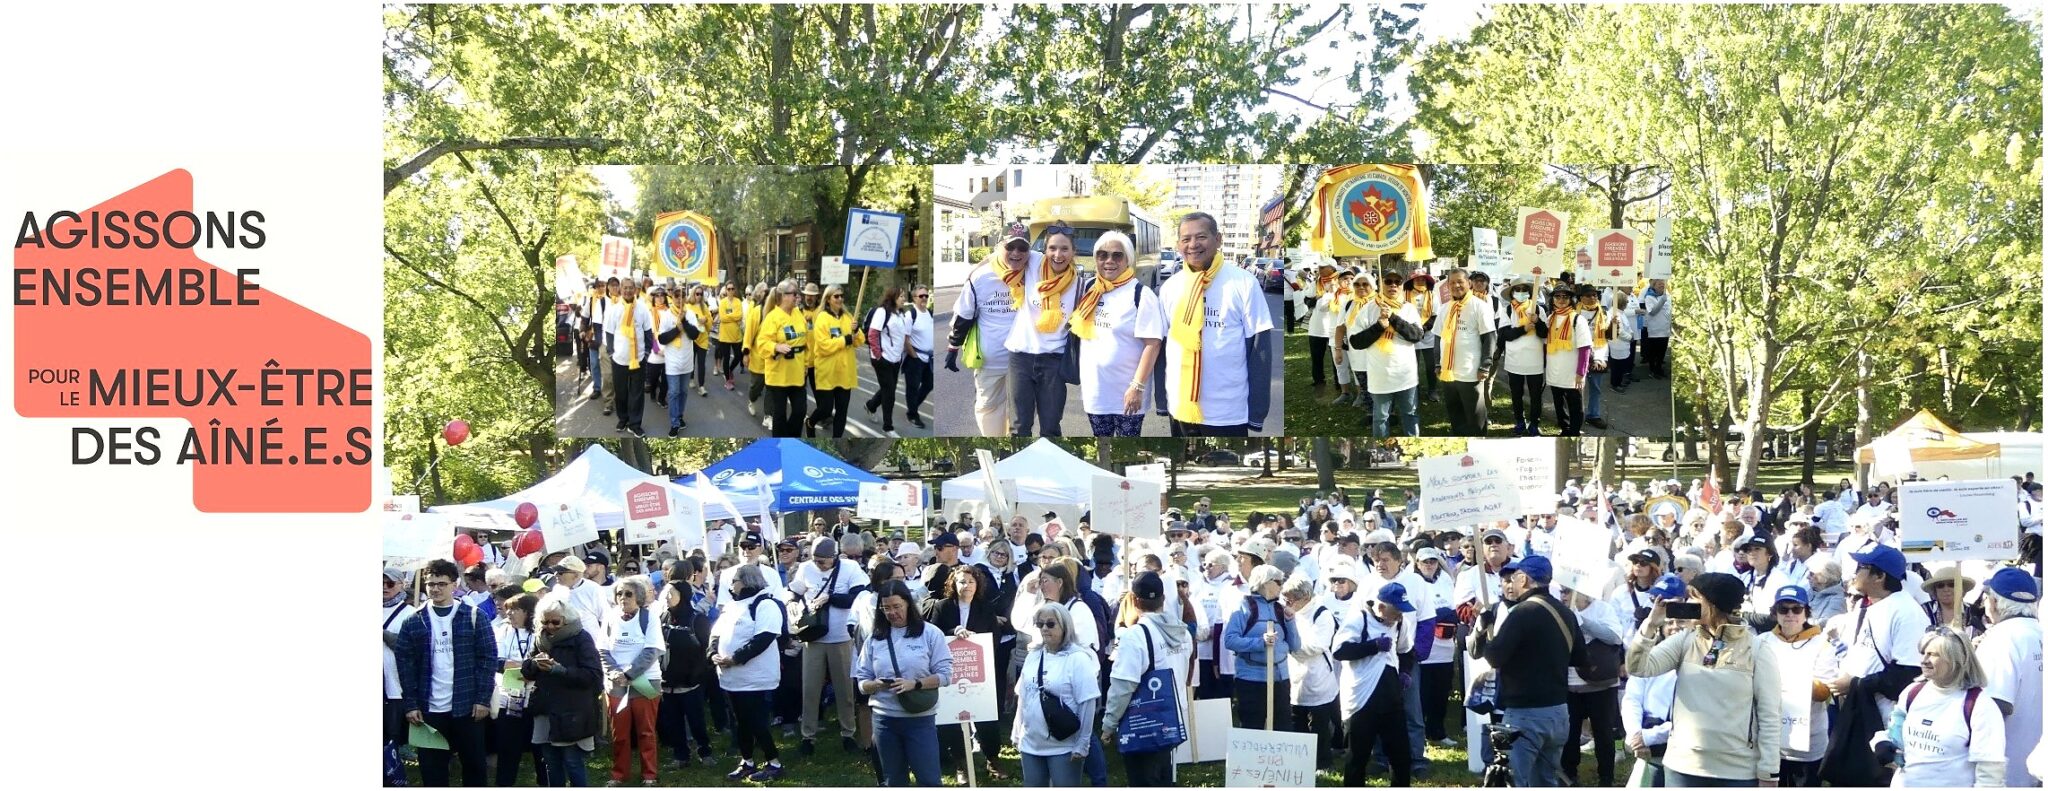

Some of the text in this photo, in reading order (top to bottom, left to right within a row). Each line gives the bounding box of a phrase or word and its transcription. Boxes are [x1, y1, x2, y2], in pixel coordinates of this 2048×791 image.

[789, 496, 829, 504] CENTRALE
[1908, 726, 1940, 743] Vieillir,
[1919, 742, 1945, 755] vivre.
